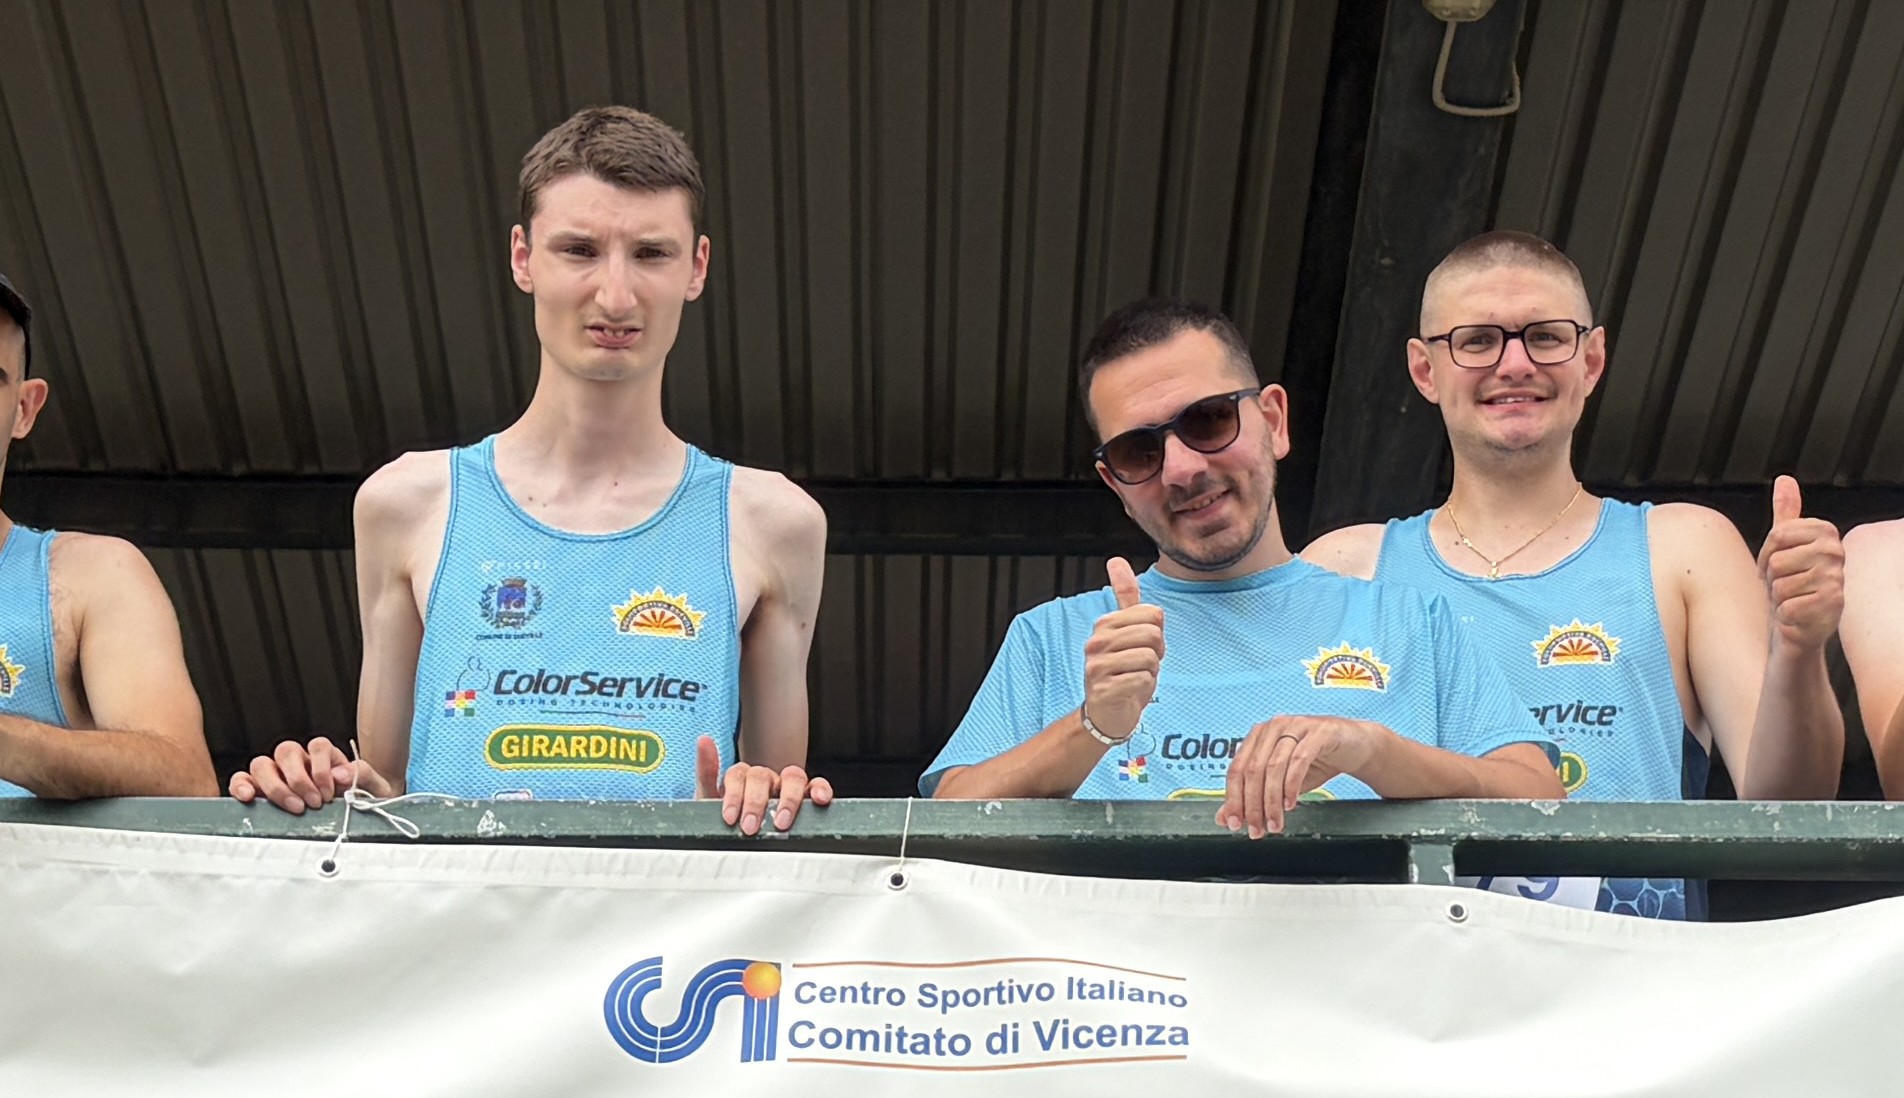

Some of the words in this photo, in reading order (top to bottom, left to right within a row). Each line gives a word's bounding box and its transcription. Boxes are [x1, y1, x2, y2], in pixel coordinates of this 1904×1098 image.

[493, 668, 698, 702] ColorService
[501, 734, 647, 762] GIRARDINI
[795, 979, 907, 1008] Centro
[917, 977, 1056, 1015] Sportivo
[1067, 975, 1189, 1009] Italiano
[787, 1020, 973, 1057] Comitato
[985, 1023, 1021, 1055] di
[1032, 1017, 1190, 1052] Vicenza
